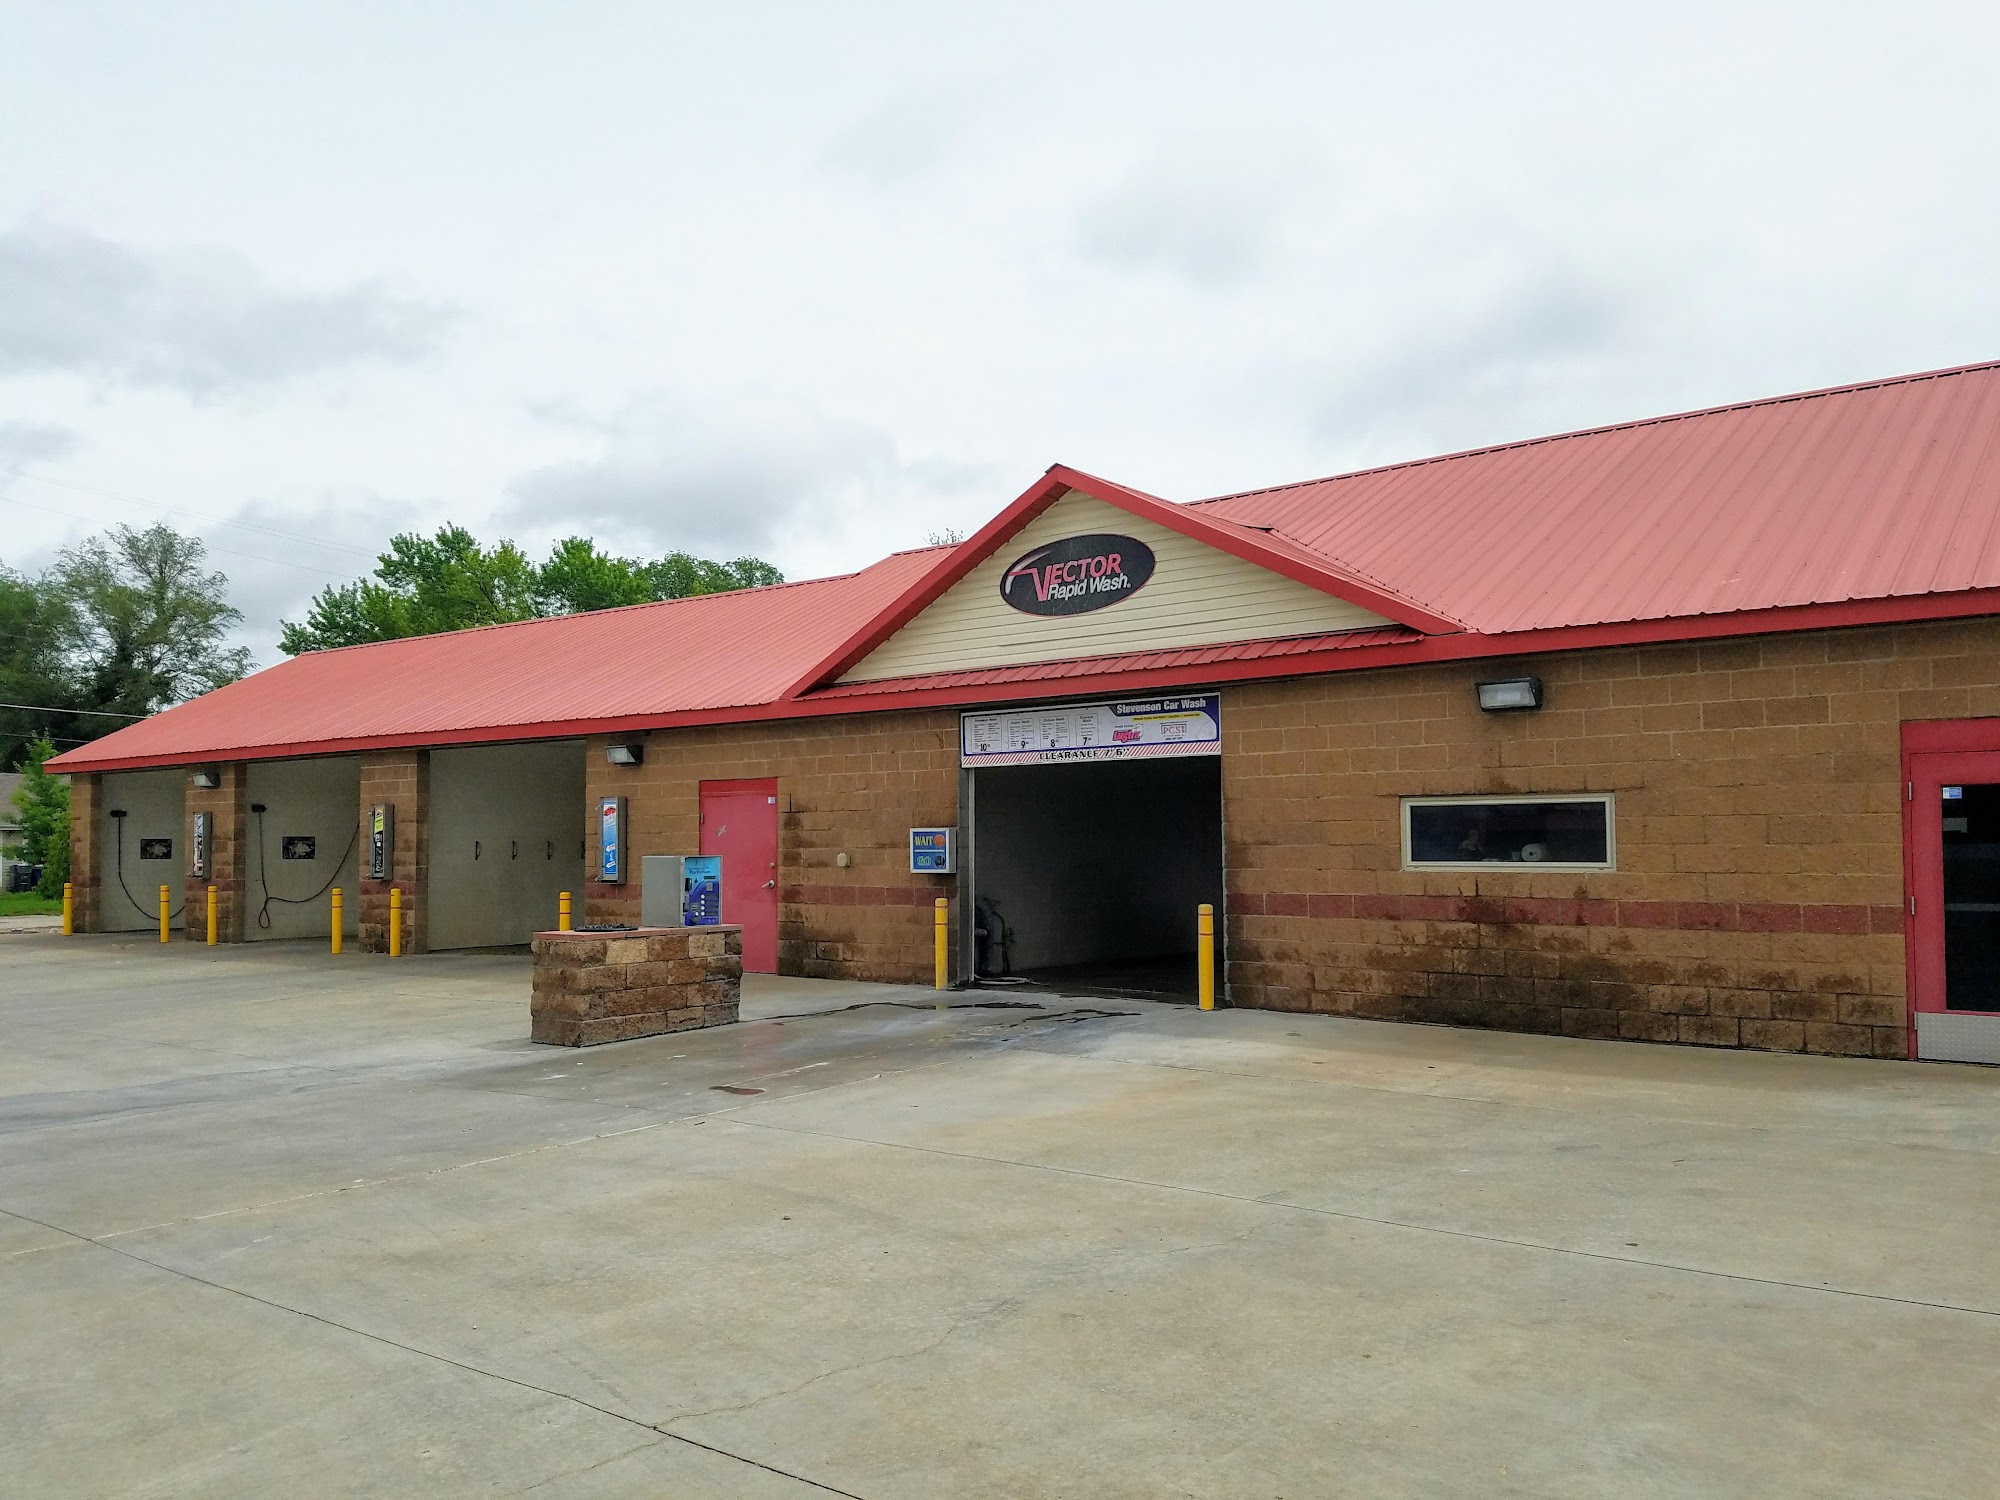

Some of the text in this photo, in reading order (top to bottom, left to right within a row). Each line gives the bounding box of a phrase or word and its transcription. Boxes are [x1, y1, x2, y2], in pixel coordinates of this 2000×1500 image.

[1008, 553, 1121, 602] VECTOR
[1048, 573, 1128, 601] Rapid Wash
[1116, 698, 1206, 713] Stevenson Car Wash
[1163, 726, 1185, 734] PCSI
[1040, 750, 1099, 760] CLEARANCE
[914, 836, 933, 846] WAIT
[917, 855, 932, 867] GO
